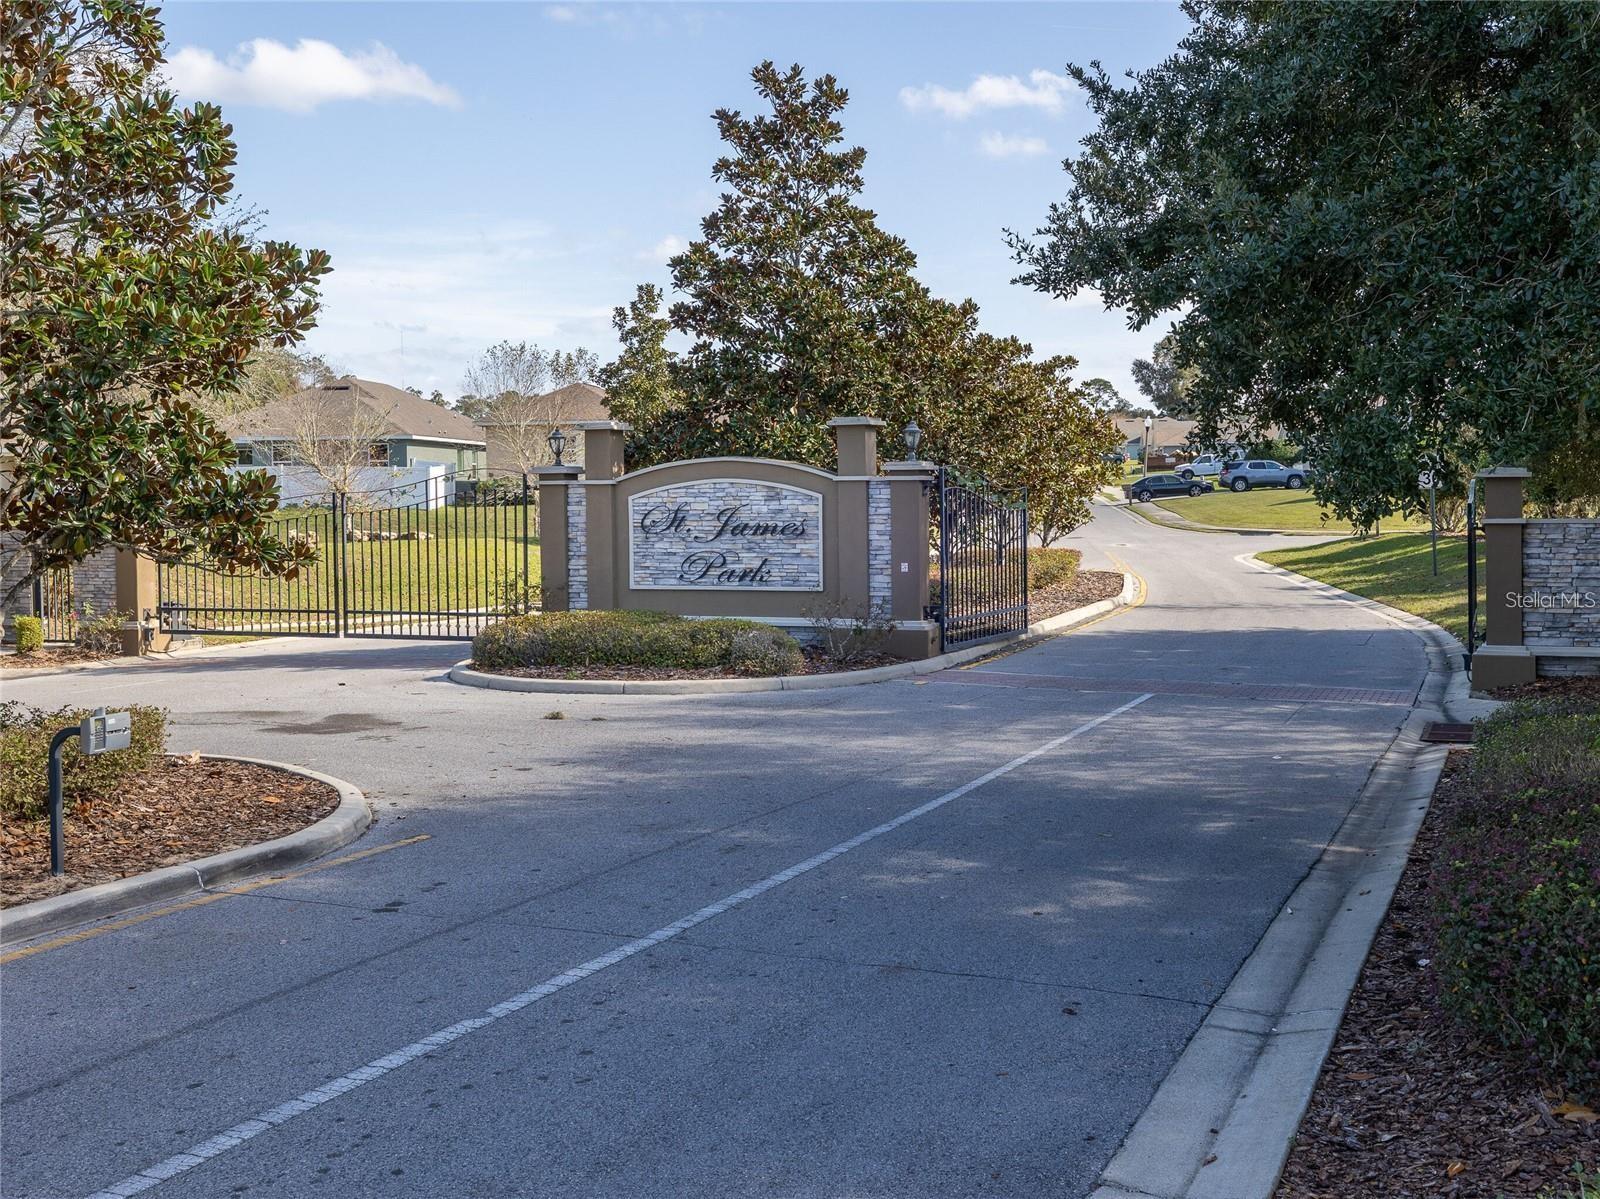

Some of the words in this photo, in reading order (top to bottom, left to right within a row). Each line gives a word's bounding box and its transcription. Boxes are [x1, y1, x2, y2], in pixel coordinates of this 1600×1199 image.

[641, 501, 691, 540] St.
[693, 503, 808, 544] James
[679, 550, 775, 583] Park
